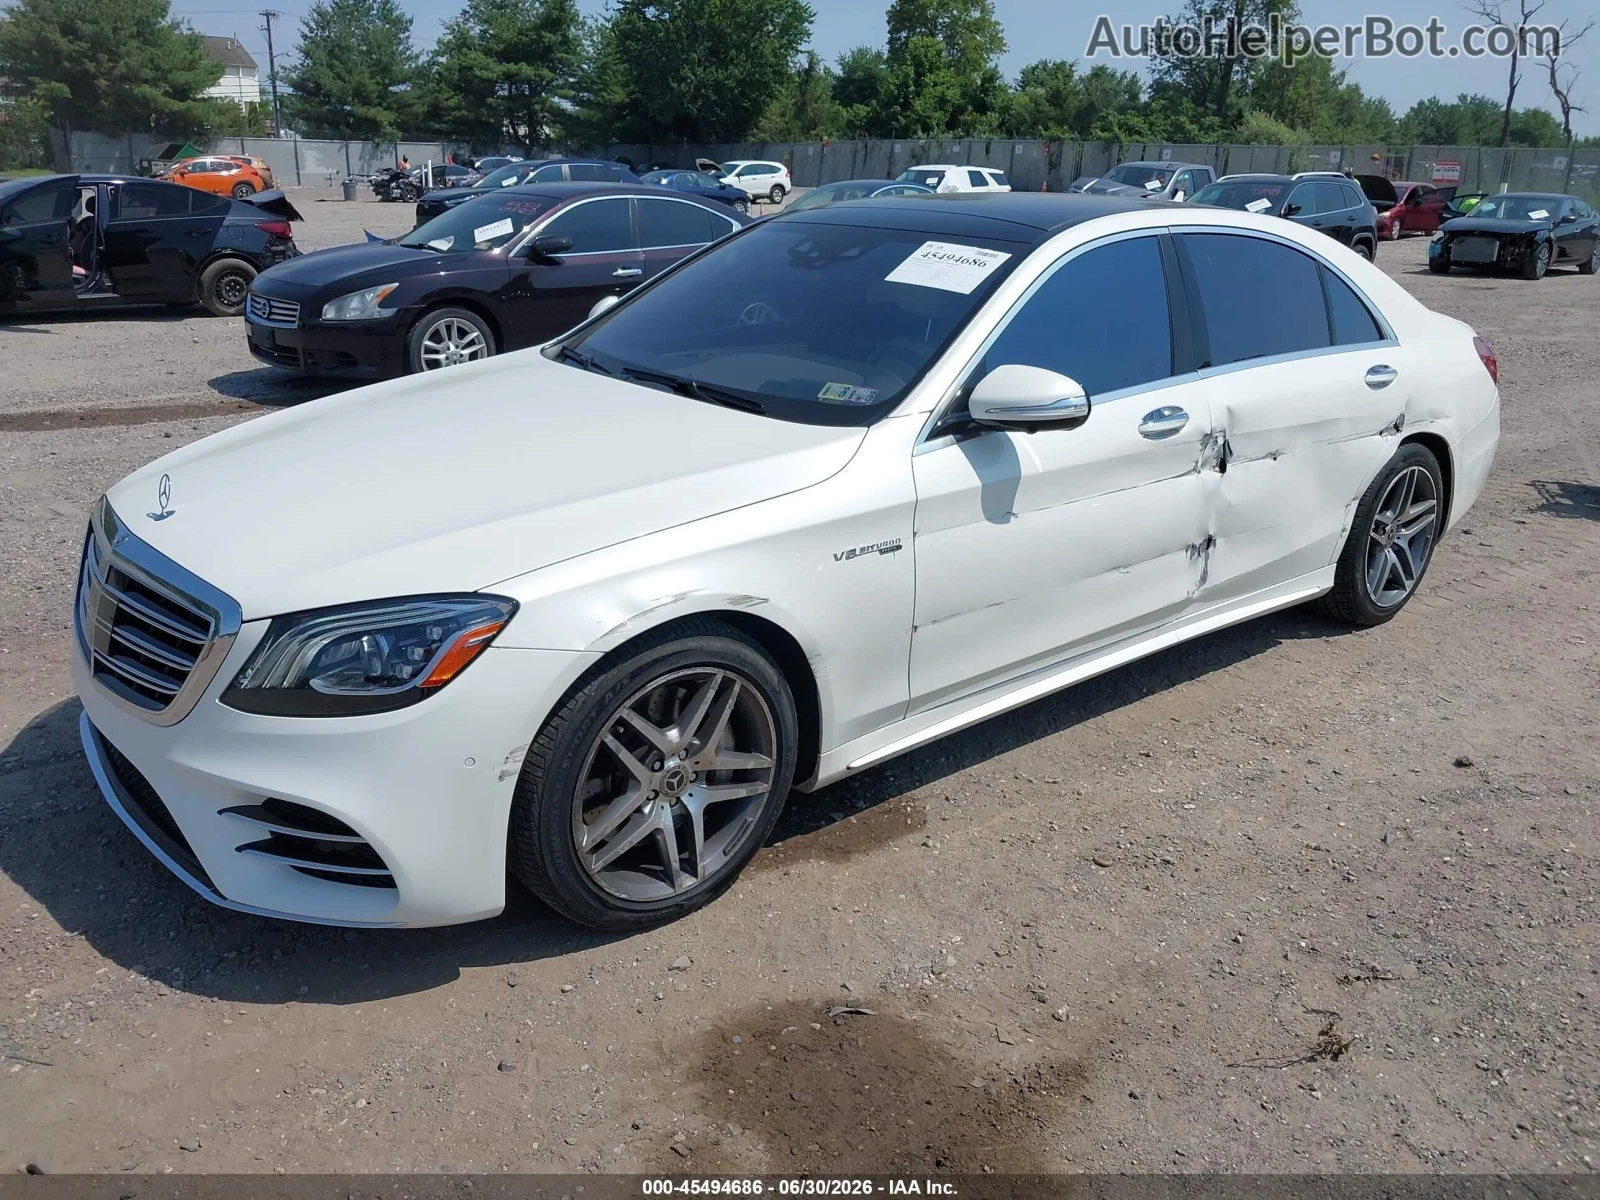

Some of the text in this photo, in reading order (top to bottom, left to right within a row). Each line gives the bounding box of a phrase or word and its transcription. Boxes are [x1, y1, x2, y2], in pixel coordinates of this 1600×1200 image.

[920, 250, 988, 269] 45494686
[833, 548, 857, 561] V8
[859, 537, 901, 554] BITURBO
